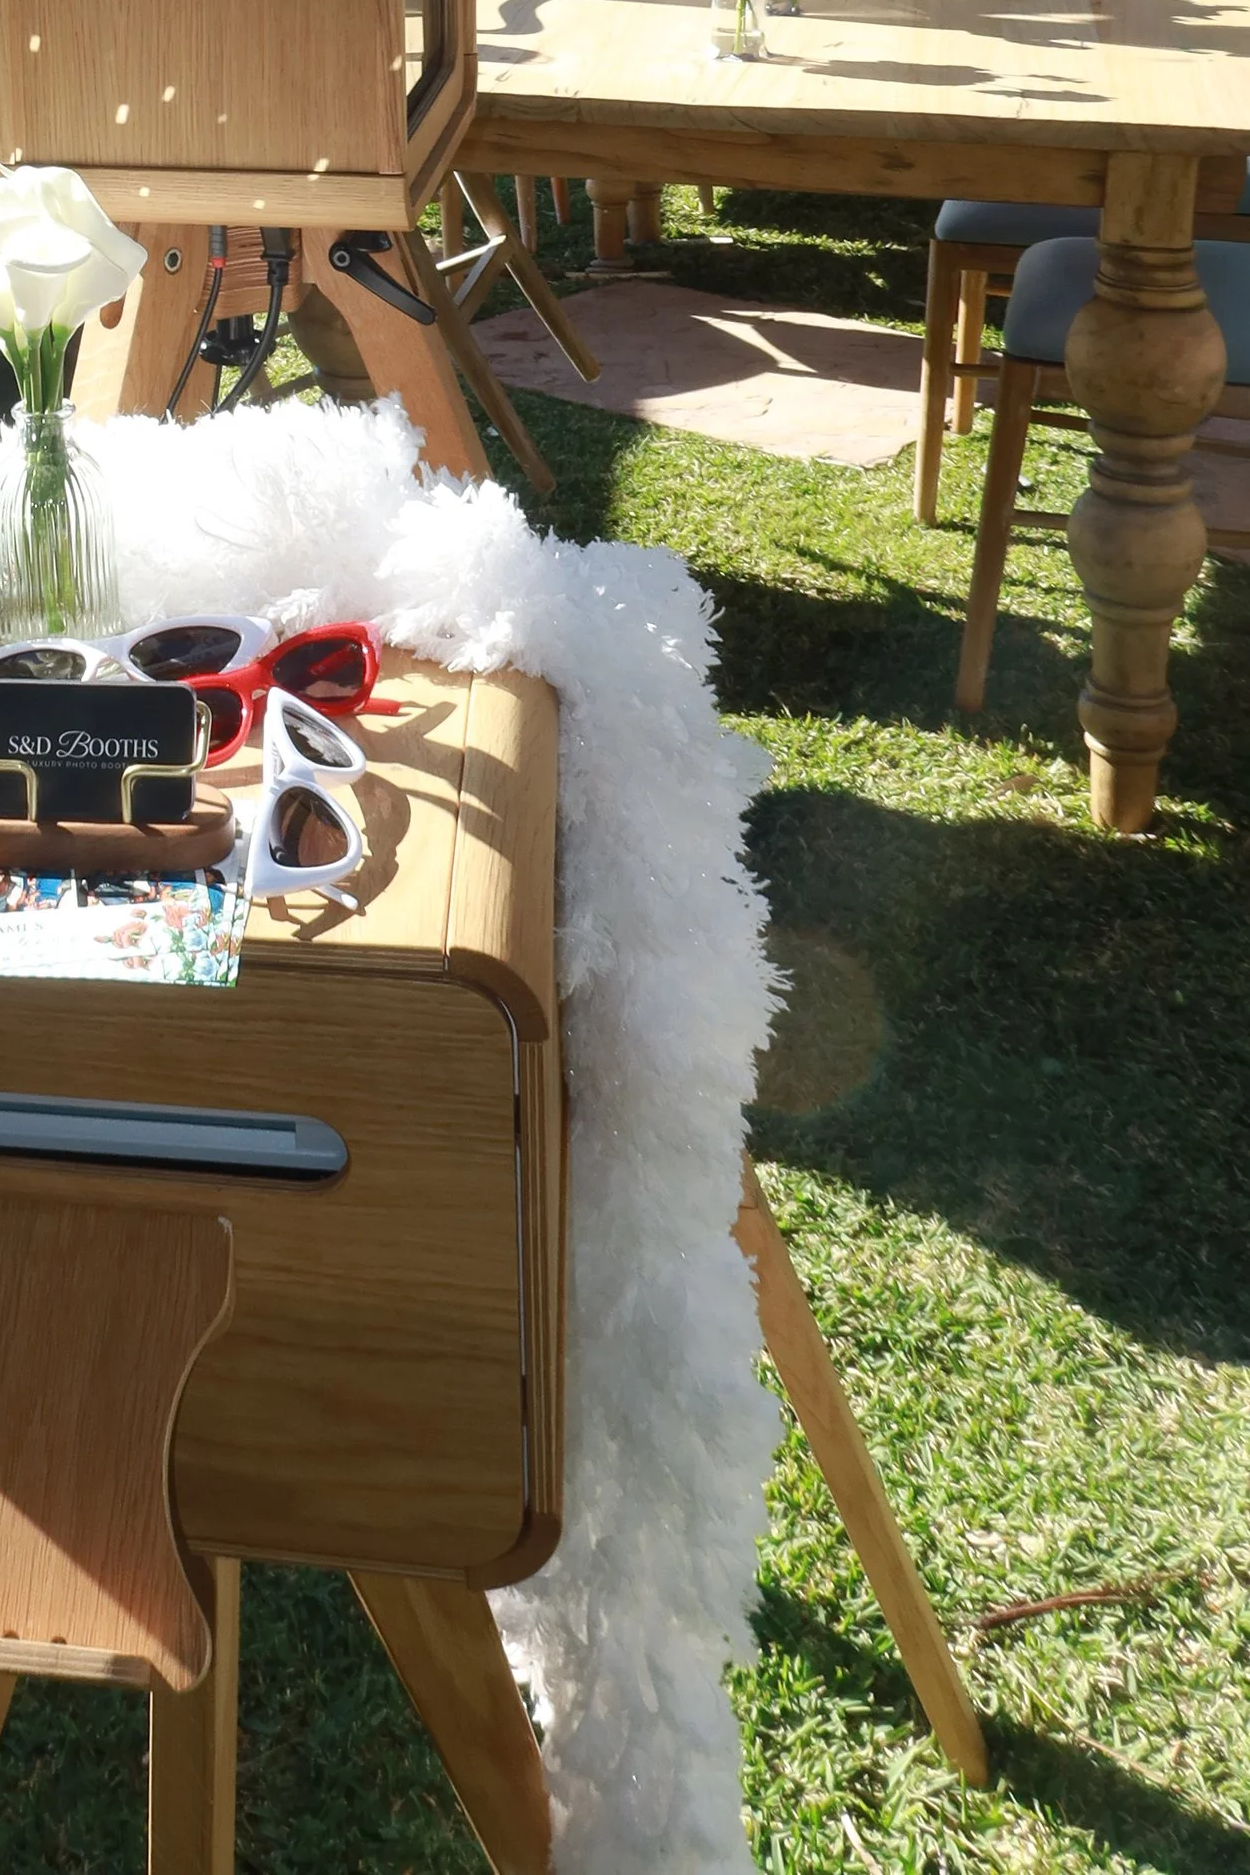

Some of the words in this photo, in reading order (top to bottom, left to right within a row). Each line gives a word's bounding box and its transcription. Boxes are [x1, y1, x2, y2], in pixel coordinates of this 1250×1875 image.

[7, 735, 52, 756] S&D
[55, 730, 159, 758] BOOTHS
[65, 760, 98, 769] PHOTO
